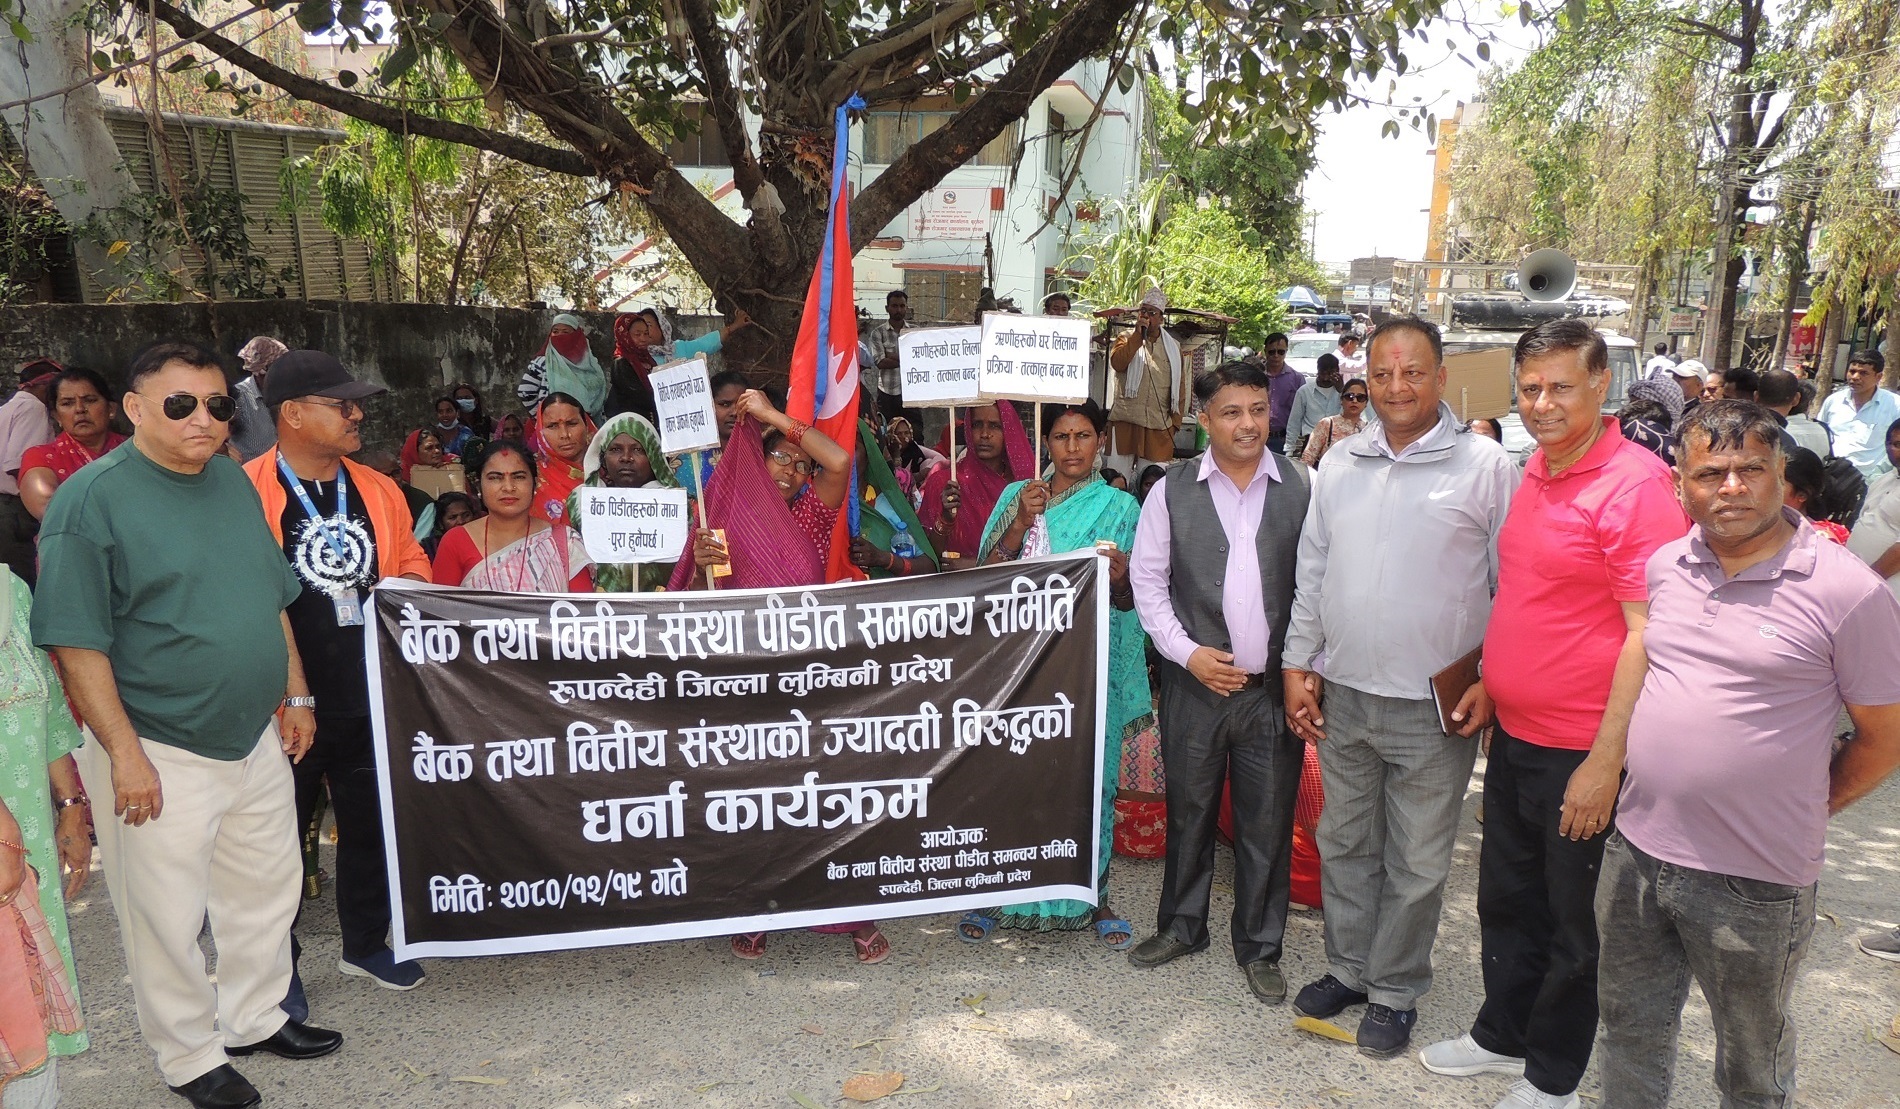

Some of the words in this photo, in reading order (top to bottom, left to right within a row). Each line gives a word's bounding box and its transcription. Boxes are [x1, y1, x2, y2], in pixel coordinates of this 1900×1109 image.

[950, 344, 960, 357] घर
[962, 339, 981, 356] लिला
[1039, 334, 1050, 350] घर
[1052, 331, 1078, 351] लिलाम
[906, 367, 930, 386] प्रक्रिया
[937, 369, 961, 383] तत्काल
[962, 368, 976, 380] बन्द
[986, 355, 1013, 375] प्रक्रिया
[1021, 361, 1048, 377] तत्काल
[1050, 363, 1064, 379] बन्द
[1067, 364, 1078, 379] गर
[661, 503, 678, 518] माग
[628, 528, 658, 552] हुनैपर्छ
[400, 602, 460, 664] बैंक
[471, 617, 539, 664] तथा
[550, 601, 647, 662] वित्तीय
[658, 602, 745, 661] संस्था
[755, 593, 847, 652] पीडीत
[857, 596, 975, 650] समन्वय
[985, 573, 1076, 638] समिति
[677, 670, 769, 698] जिल्ला
[778, 658, 882, 697] लुम्बिनी
[890, 654, 953, 687] प्रदेश
[412, 731, 474, 783] बैंक
[485, 737, 556, 782] तथा
[566, 720, 668, 774] वित्तीय
[678, 709, 812, 769] संस्थाको
[822, 702, 943, 756] ज्यादती
[581, 781, 688, 843] धर्ना
[705, 771, 933, 834] कार्यक्रम
[852, 861, 876, 879] तथा
[879, 855, 915, 876] वित्तीय
[919, 854, 952, 873] संस्था
[955, 848, 989, 868] पीडीत
[992, 846, 1037, 865] समन्वय
[1040, 838, 1078, 860] समिति
[500, 869, 642, 910] २०८०/१२/१९
[650, 858, 688, 896] गते
[928, 877, 962, 891] जिल्ला
[965, 870, 1004, 889] लुम्बिनी
[1007, 869, 1031, 885] प्रदेश
